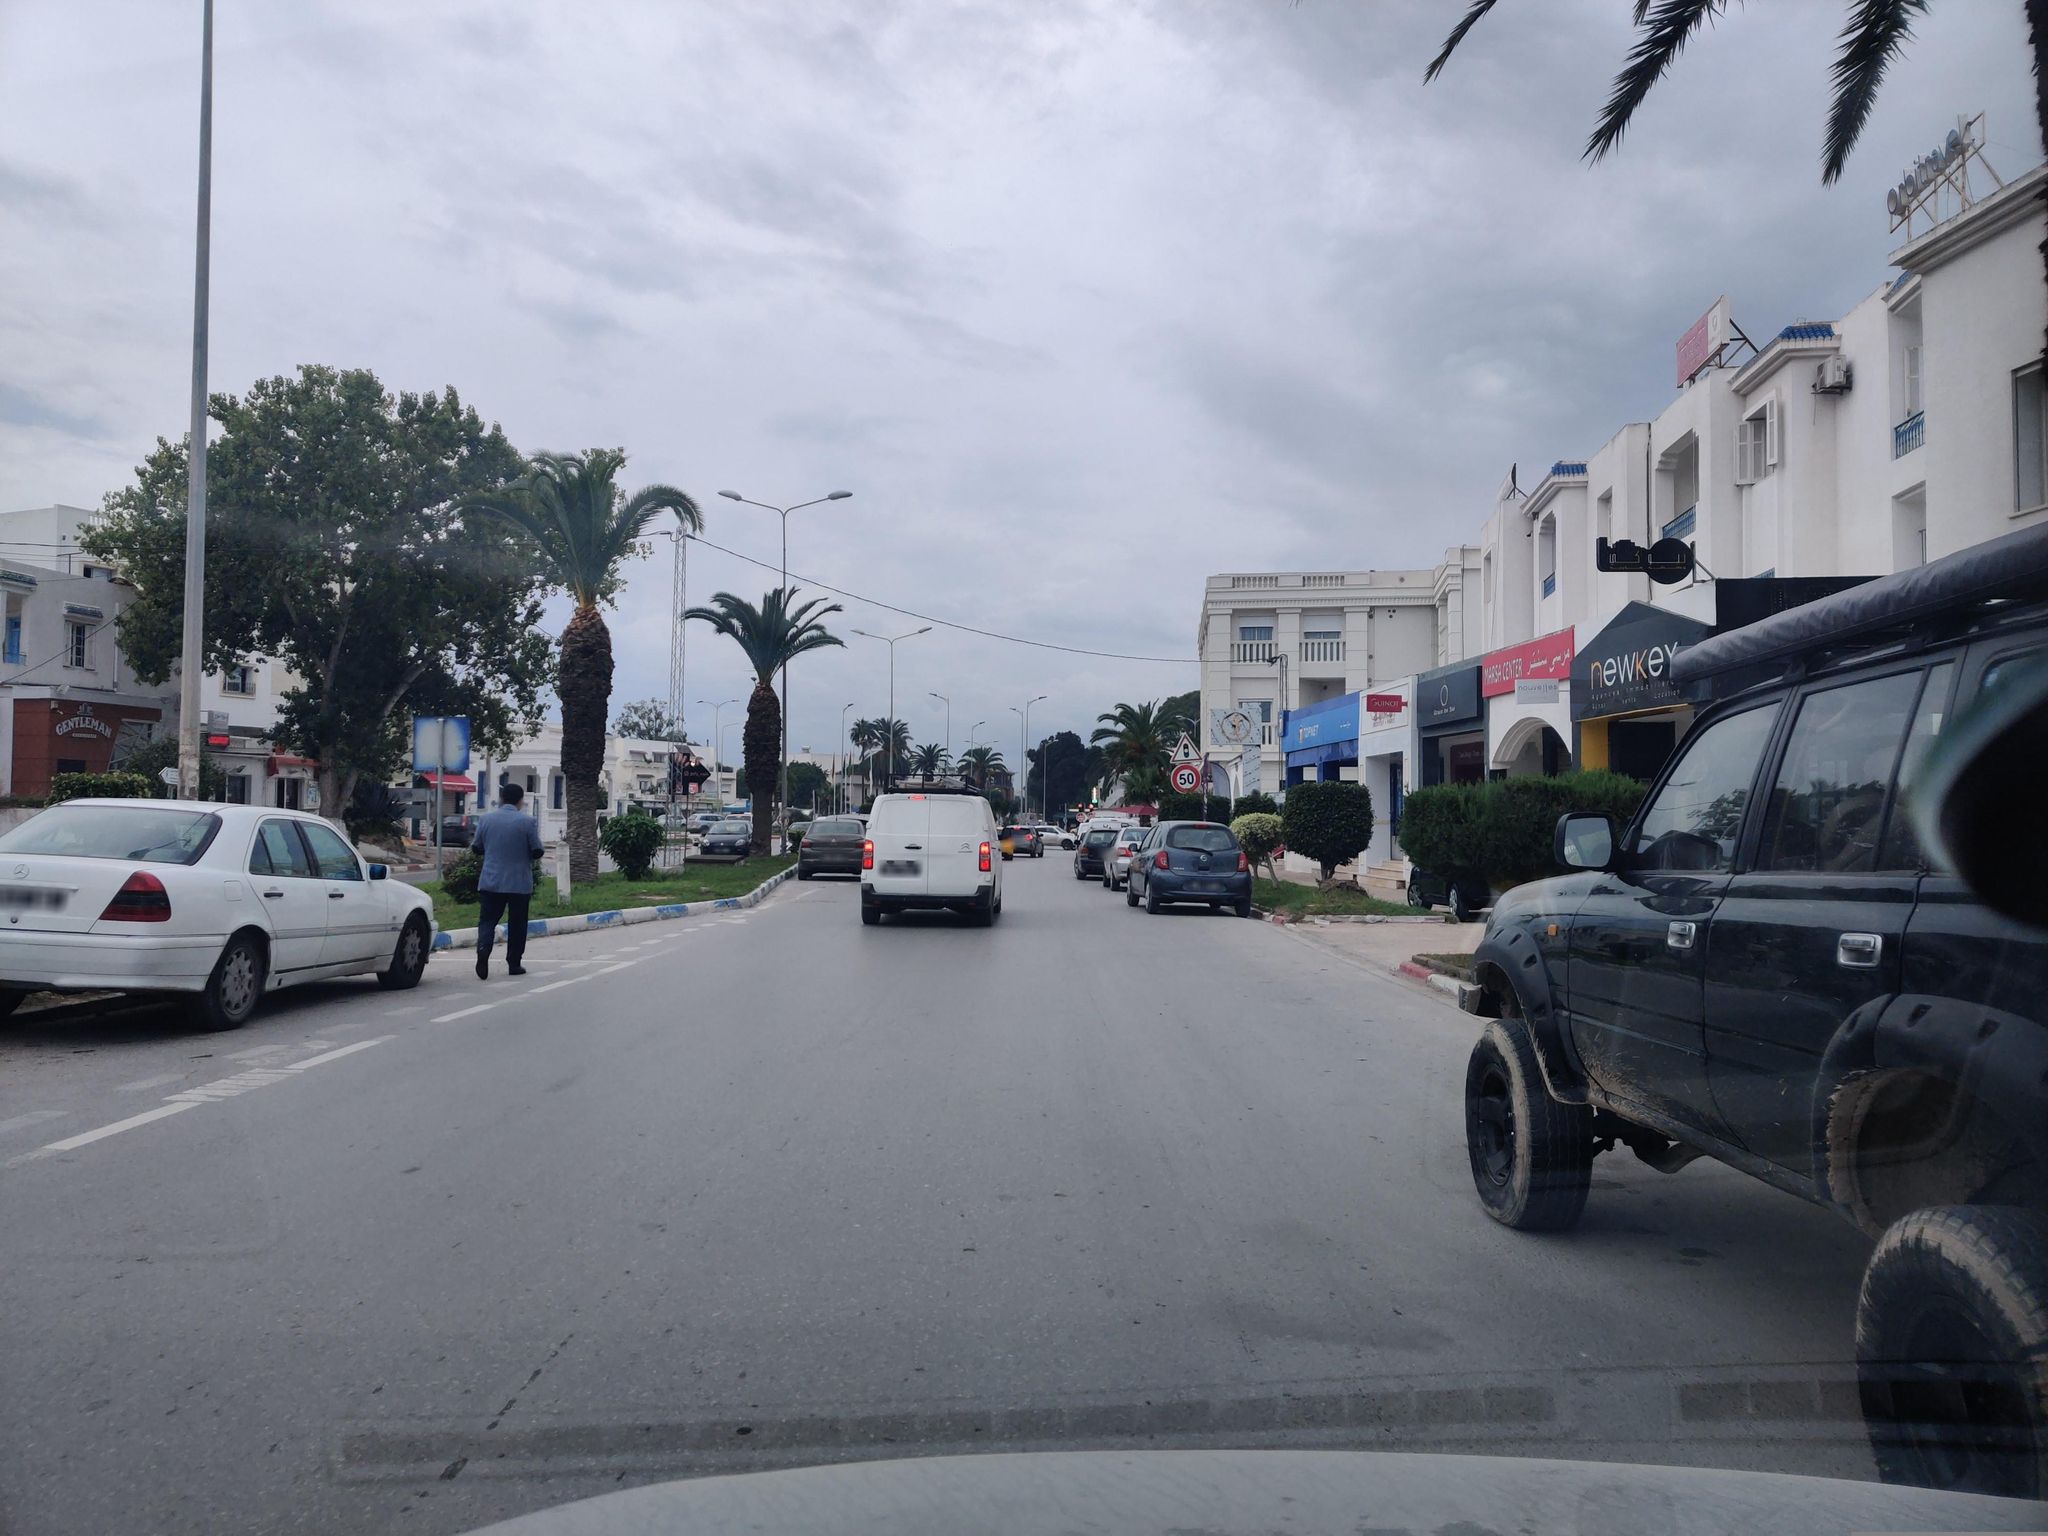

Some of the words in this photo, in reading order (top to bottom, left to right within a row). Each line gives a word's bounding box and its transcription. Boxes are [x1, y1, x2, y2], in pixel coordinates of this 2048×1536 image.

[1484, 664, 1503, 684] MARSA
[1502, 658, 1524, 681] CENTER
[56, 716, 113, 738] GENTLEMAN
[1179, 772, 1194, 786] 50
